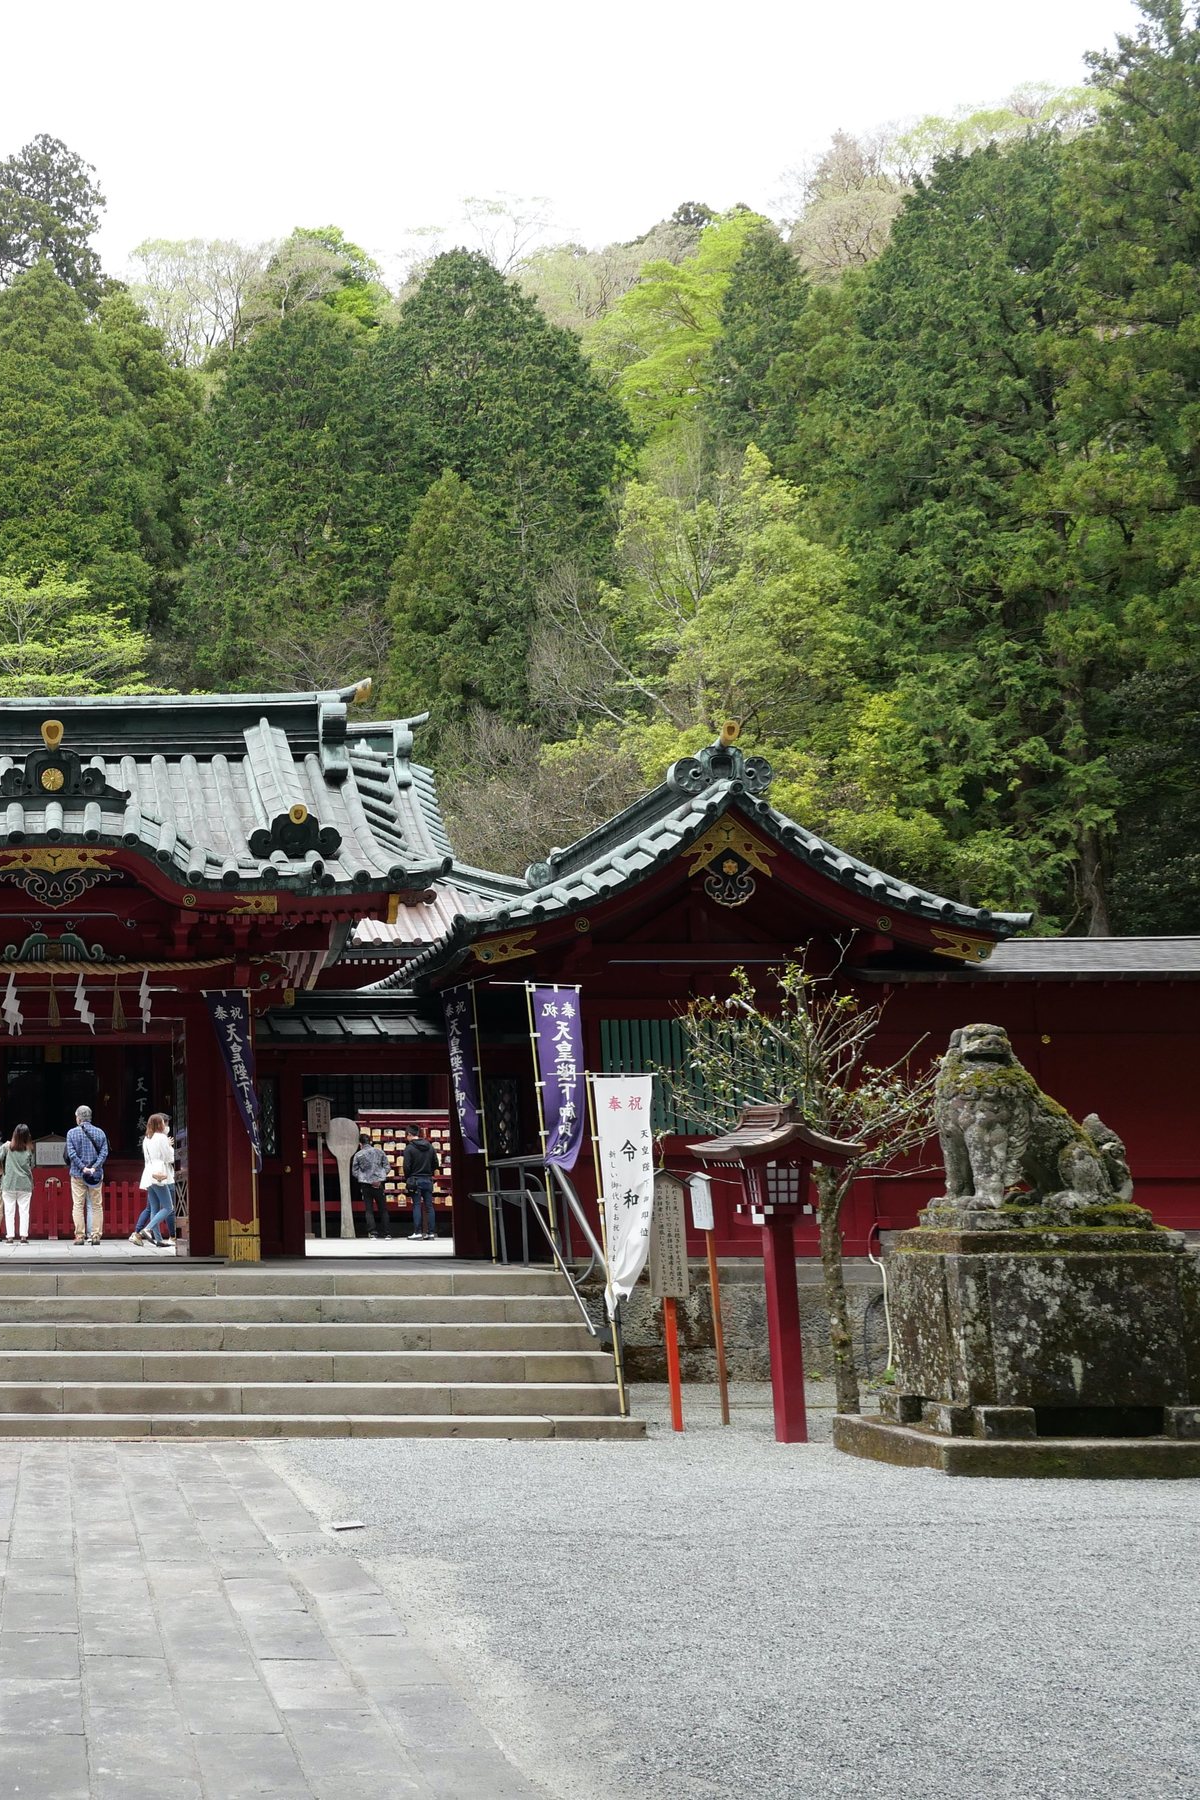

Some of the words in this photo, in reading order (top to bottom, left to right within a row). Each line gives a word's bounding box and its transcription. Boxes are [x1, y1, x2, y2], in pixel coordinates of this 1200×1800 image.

[213, 1004, 244, 1020] 奉祝
[607, 1095, 643, 1111] 奉祝
[619, 1139, 640, 1209] 令和
[608, 1150, 620, 1267] 新しい御代をお祝いしま
